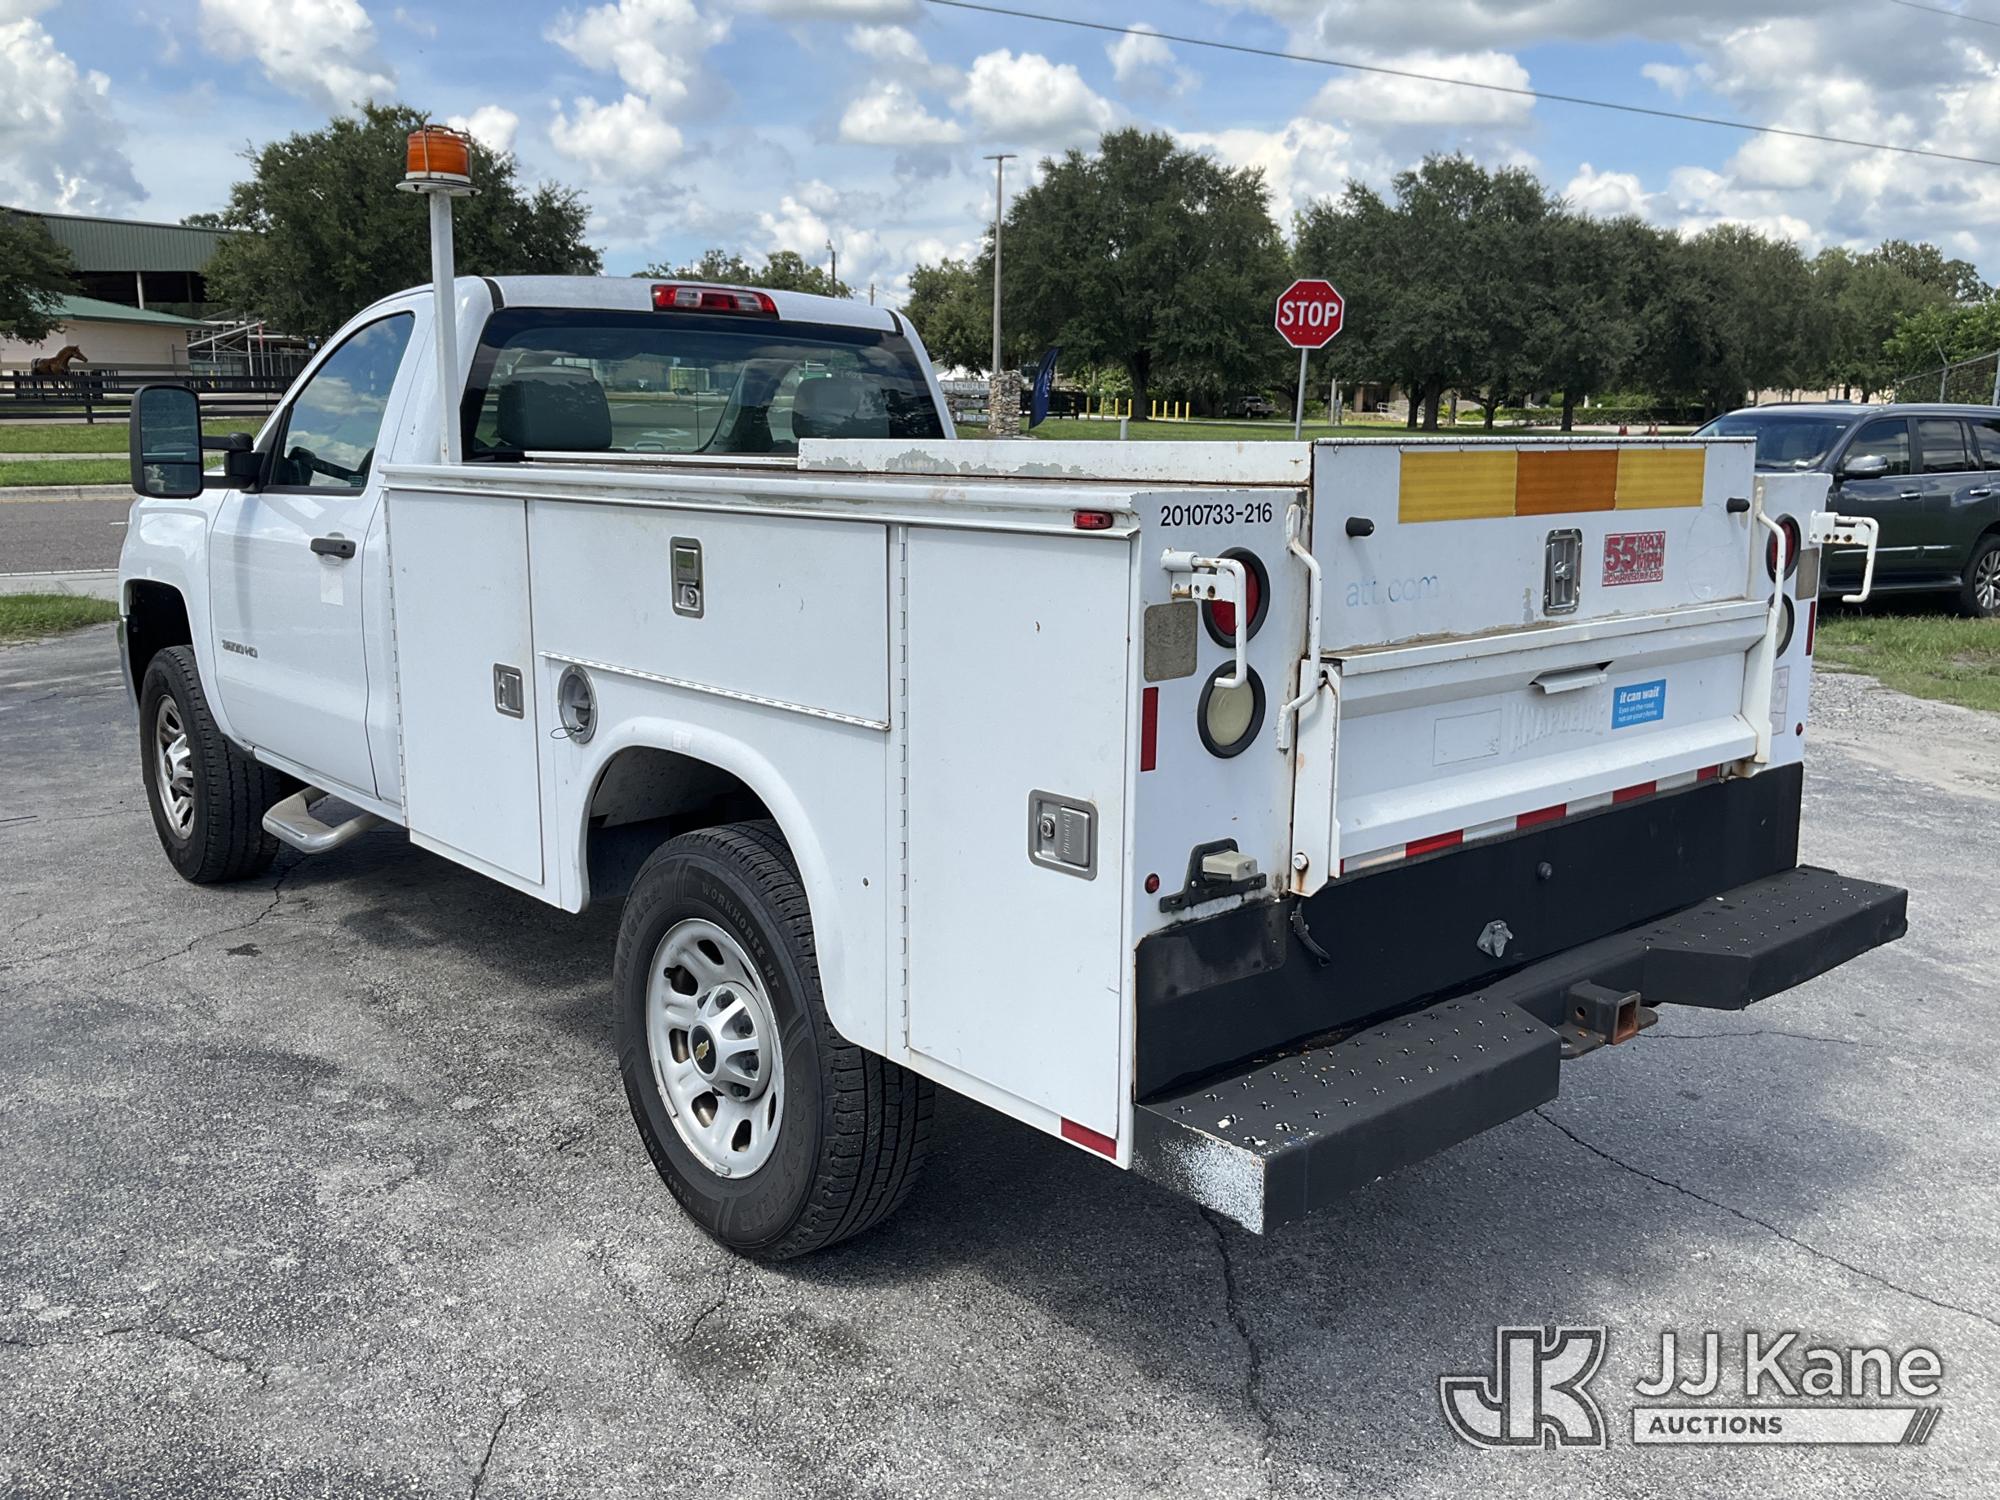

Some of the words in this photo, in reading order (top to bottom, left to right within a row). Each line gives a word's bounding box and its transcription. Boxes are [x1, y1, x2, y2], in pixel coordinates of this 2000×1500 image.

[1280, 300, 1339, 327] STOP
[1160, 502, 1273, 526] 2010733-216
[1605, 536, 1637, 573] 55
[1619, 691, 1627, 704] it
[1626, 691, 1642, 703] can
[1642, 686, 1660, 699] wait
[702, 882, 766, 958] WORKHORSE
